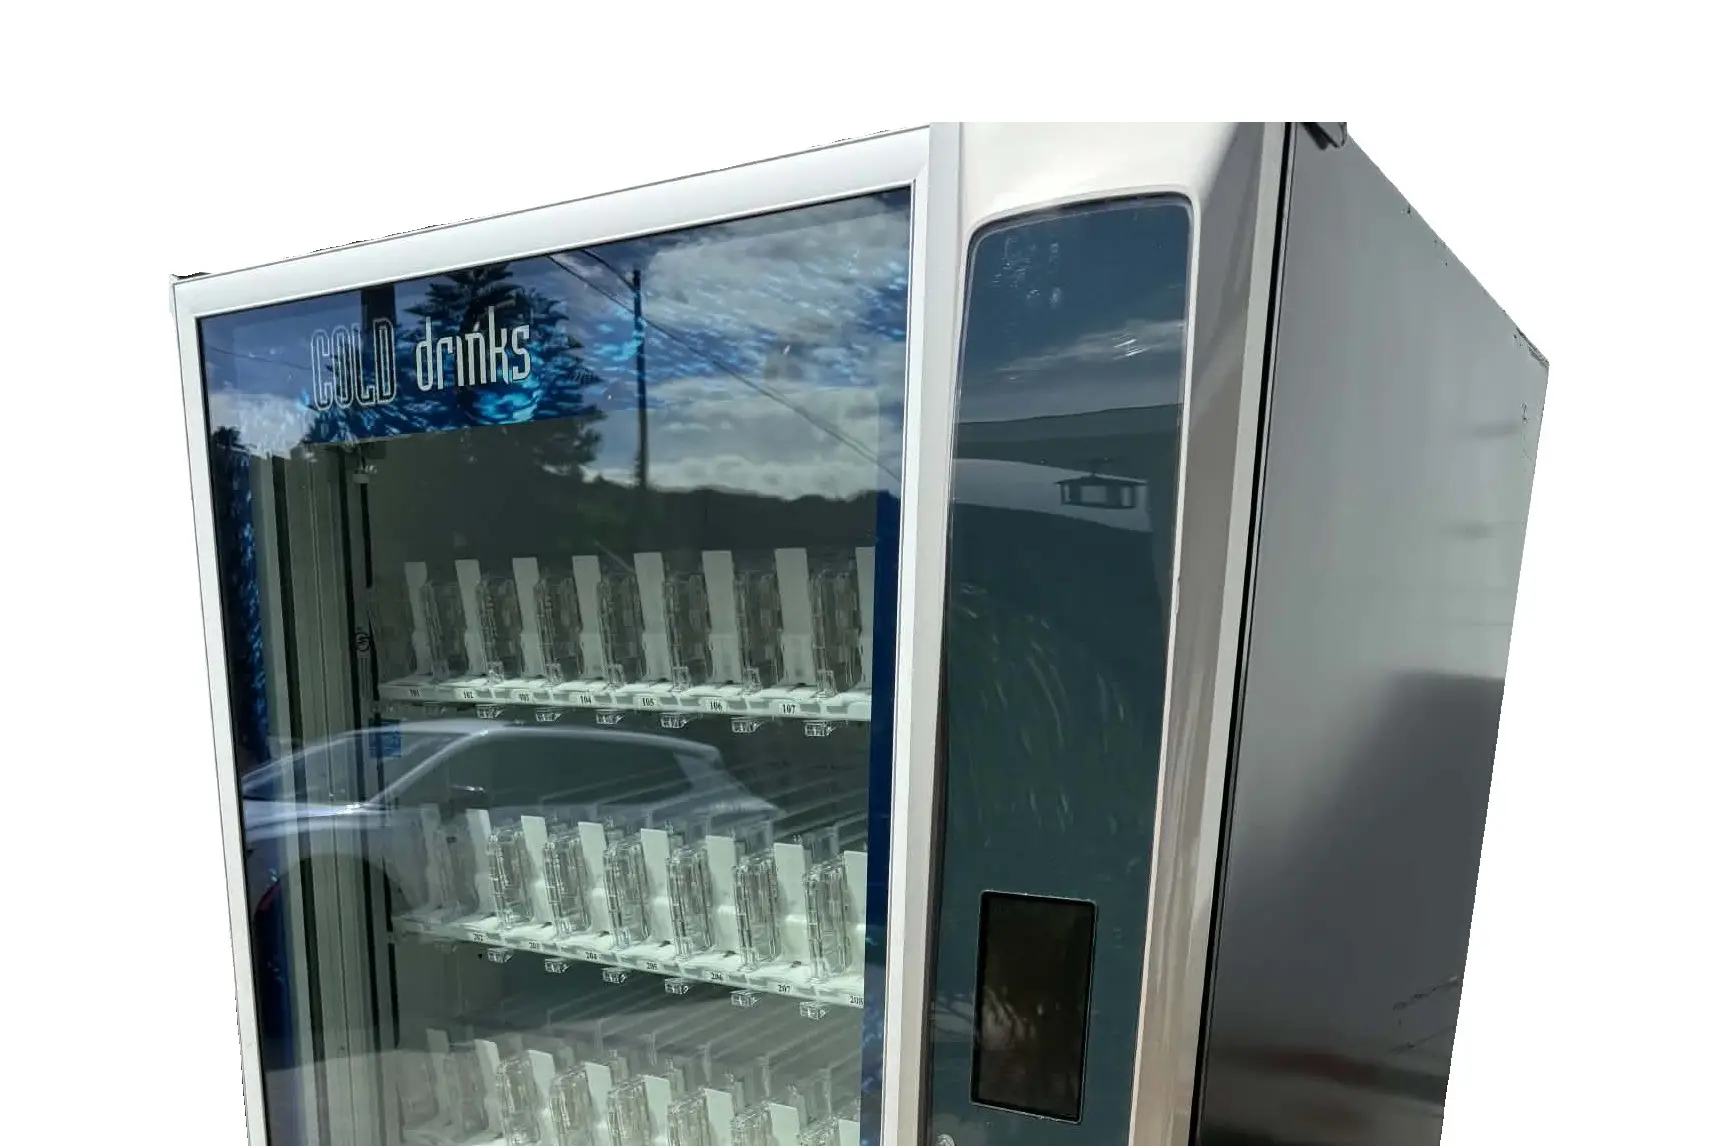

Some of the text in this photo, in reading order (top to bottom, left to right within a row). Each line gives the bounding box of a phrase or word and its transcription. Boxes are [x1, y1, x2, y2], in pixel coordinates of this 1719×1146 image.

[311, 305, 532, 411] COLD drinks
[580, 695, 592, 705] 104
[641, 697, 655, 707] 105
[709, 701, 723, 711] 106
[782, 703, 796, 714] 107
[778, 984, 791, 994] 207
